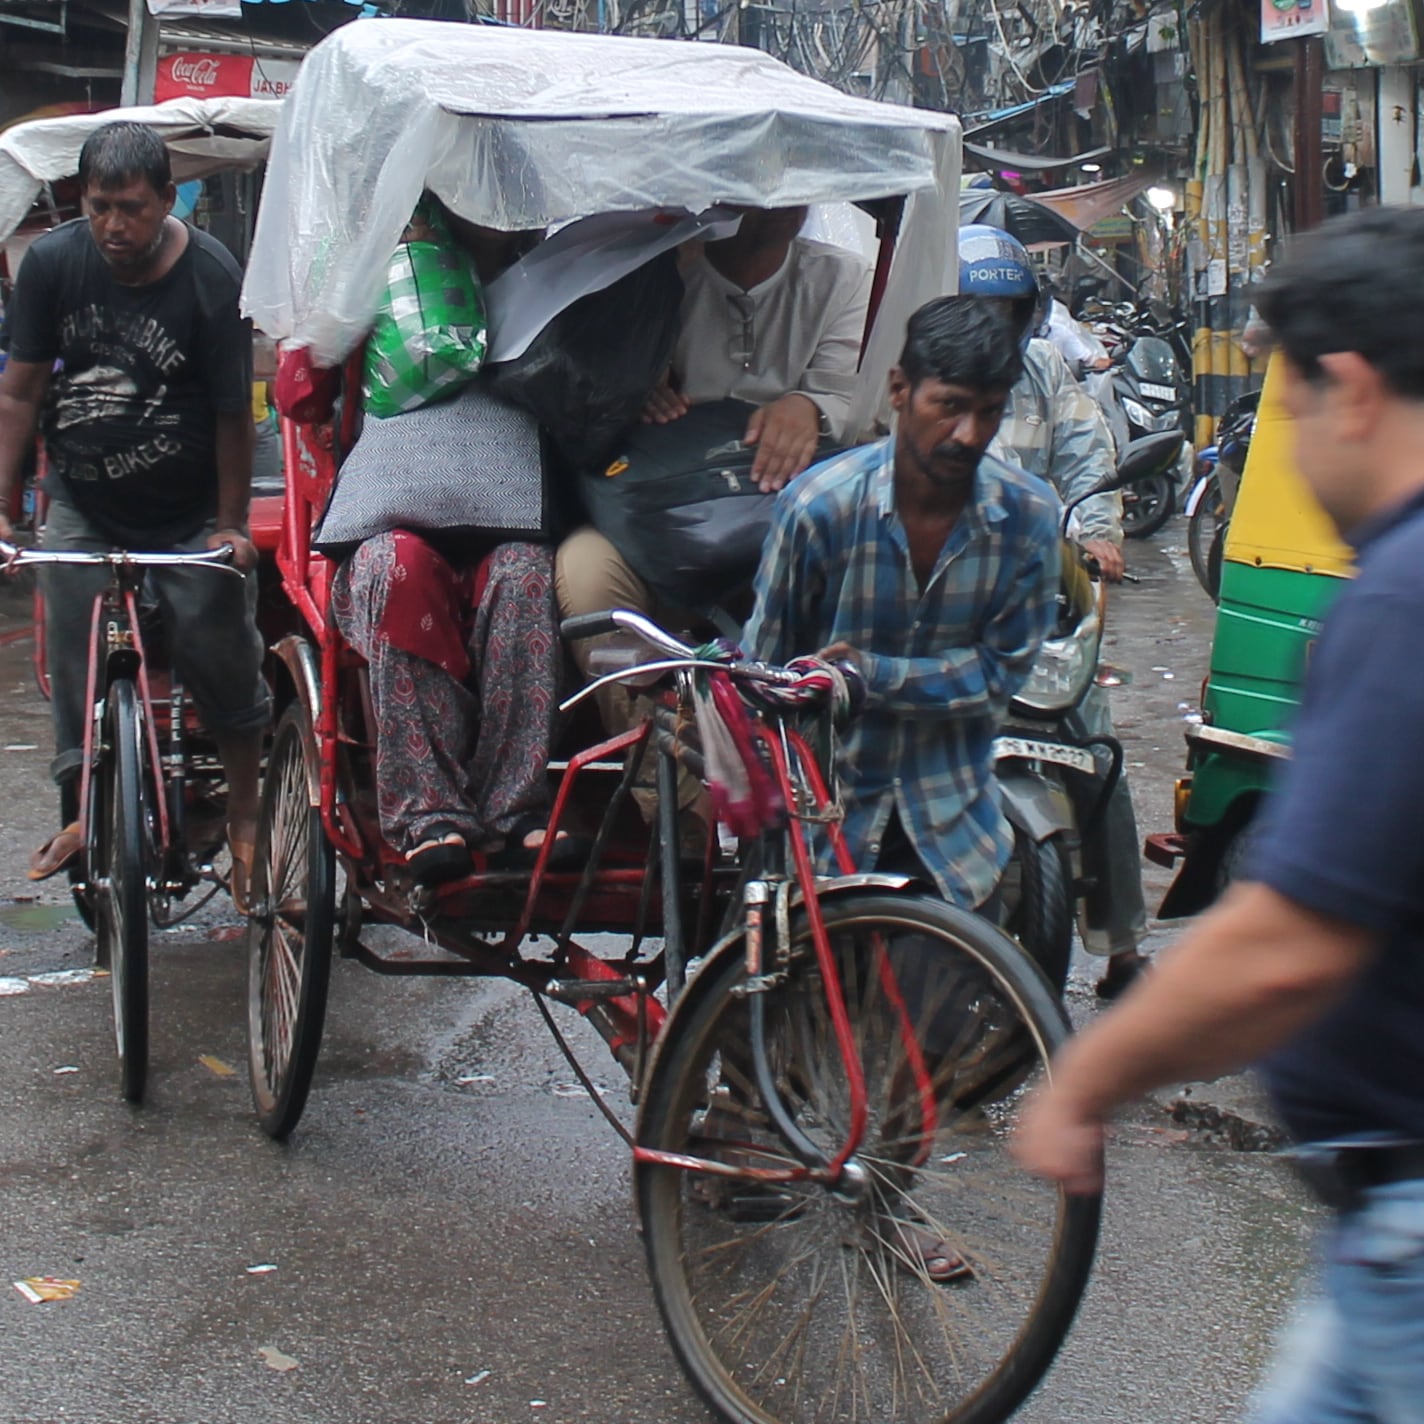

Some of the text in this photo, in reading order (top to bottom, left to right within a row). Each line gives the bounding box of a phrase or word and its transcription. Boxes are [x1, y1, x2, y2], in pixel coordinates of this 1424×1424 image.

[171, 56, 221, 85] Coca-Cola
[253, 80, 273, 93] JAI
[969, 268, 1022, 283] PORTER
[104, 433, 182, 480] BIKES
